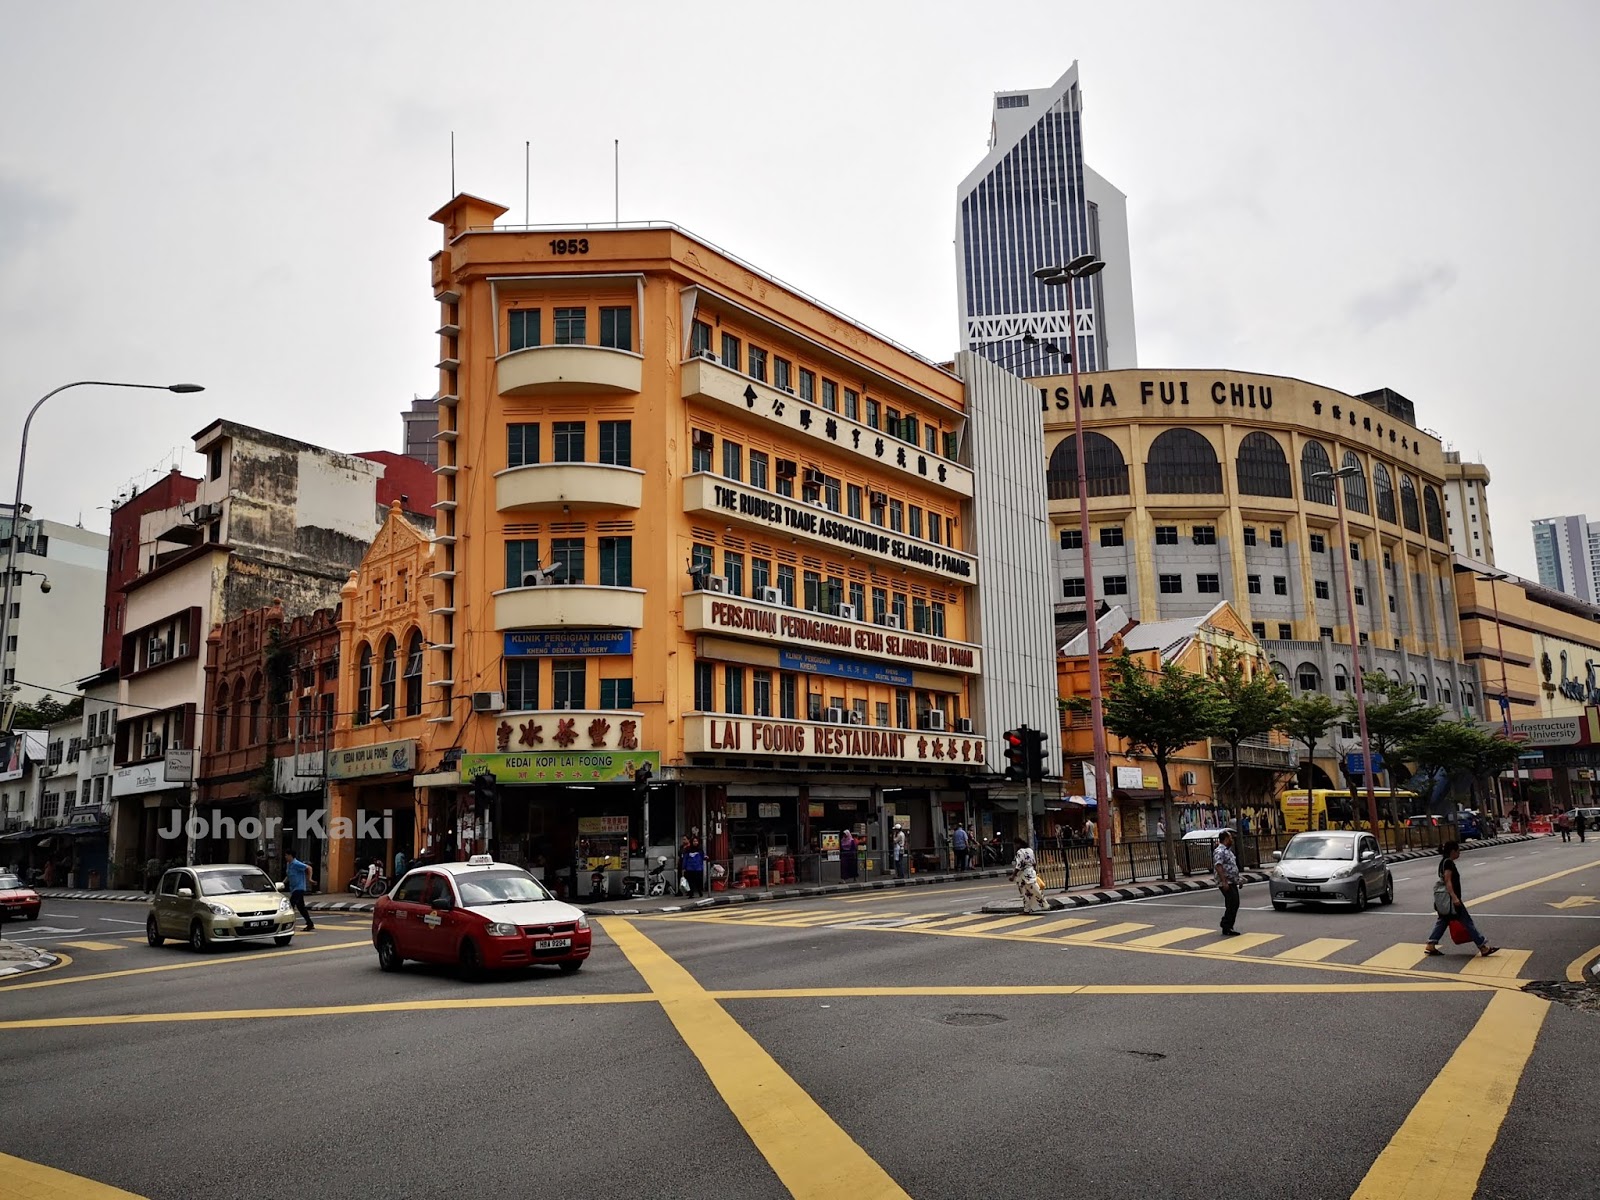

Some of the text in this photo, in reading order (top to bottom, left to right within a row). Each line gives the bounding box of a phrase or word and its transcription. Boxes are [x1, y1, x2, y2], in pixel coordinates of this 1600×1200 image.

[548, 238, 589, 255] 1953
[1041, 381, 1273, 411] ISMA FUI CHIU
[714, 485, 737, 510] THE
[740, 493, 782, 524] RUBBER
[784, 506, 818, 534] TRADE
[818, 518, 878, 553] ASSOCIATION
[879, 535, 890, 554] OF
[891, 539, 934, 567] SELANGOR
[941, 554, 971, 578] PAHANG
[511, 633, 624, 643] KLINIK PERGIGIAN KHENG
[711, 601, 777, 634] PERSATUAN
[780, 614, 851, 647] PERDAGANGAN
[855, 629, 883, 653] GETAH
[886, 635, 929, 660] SELANGOR
[931, 643, 948, 664] DAN
[579, 646, 608, 654] SURGERY
[1512, 721, 1576, 732] Infrastructure
[710, 719, 907, 759] LAI FOONG RESTAURANT
[1529, 729, 1577, 740] University
[374, 747, 388, 759] FOONG
[505, 756, 613, 768] KEDAI KOPI LAI FOONG
